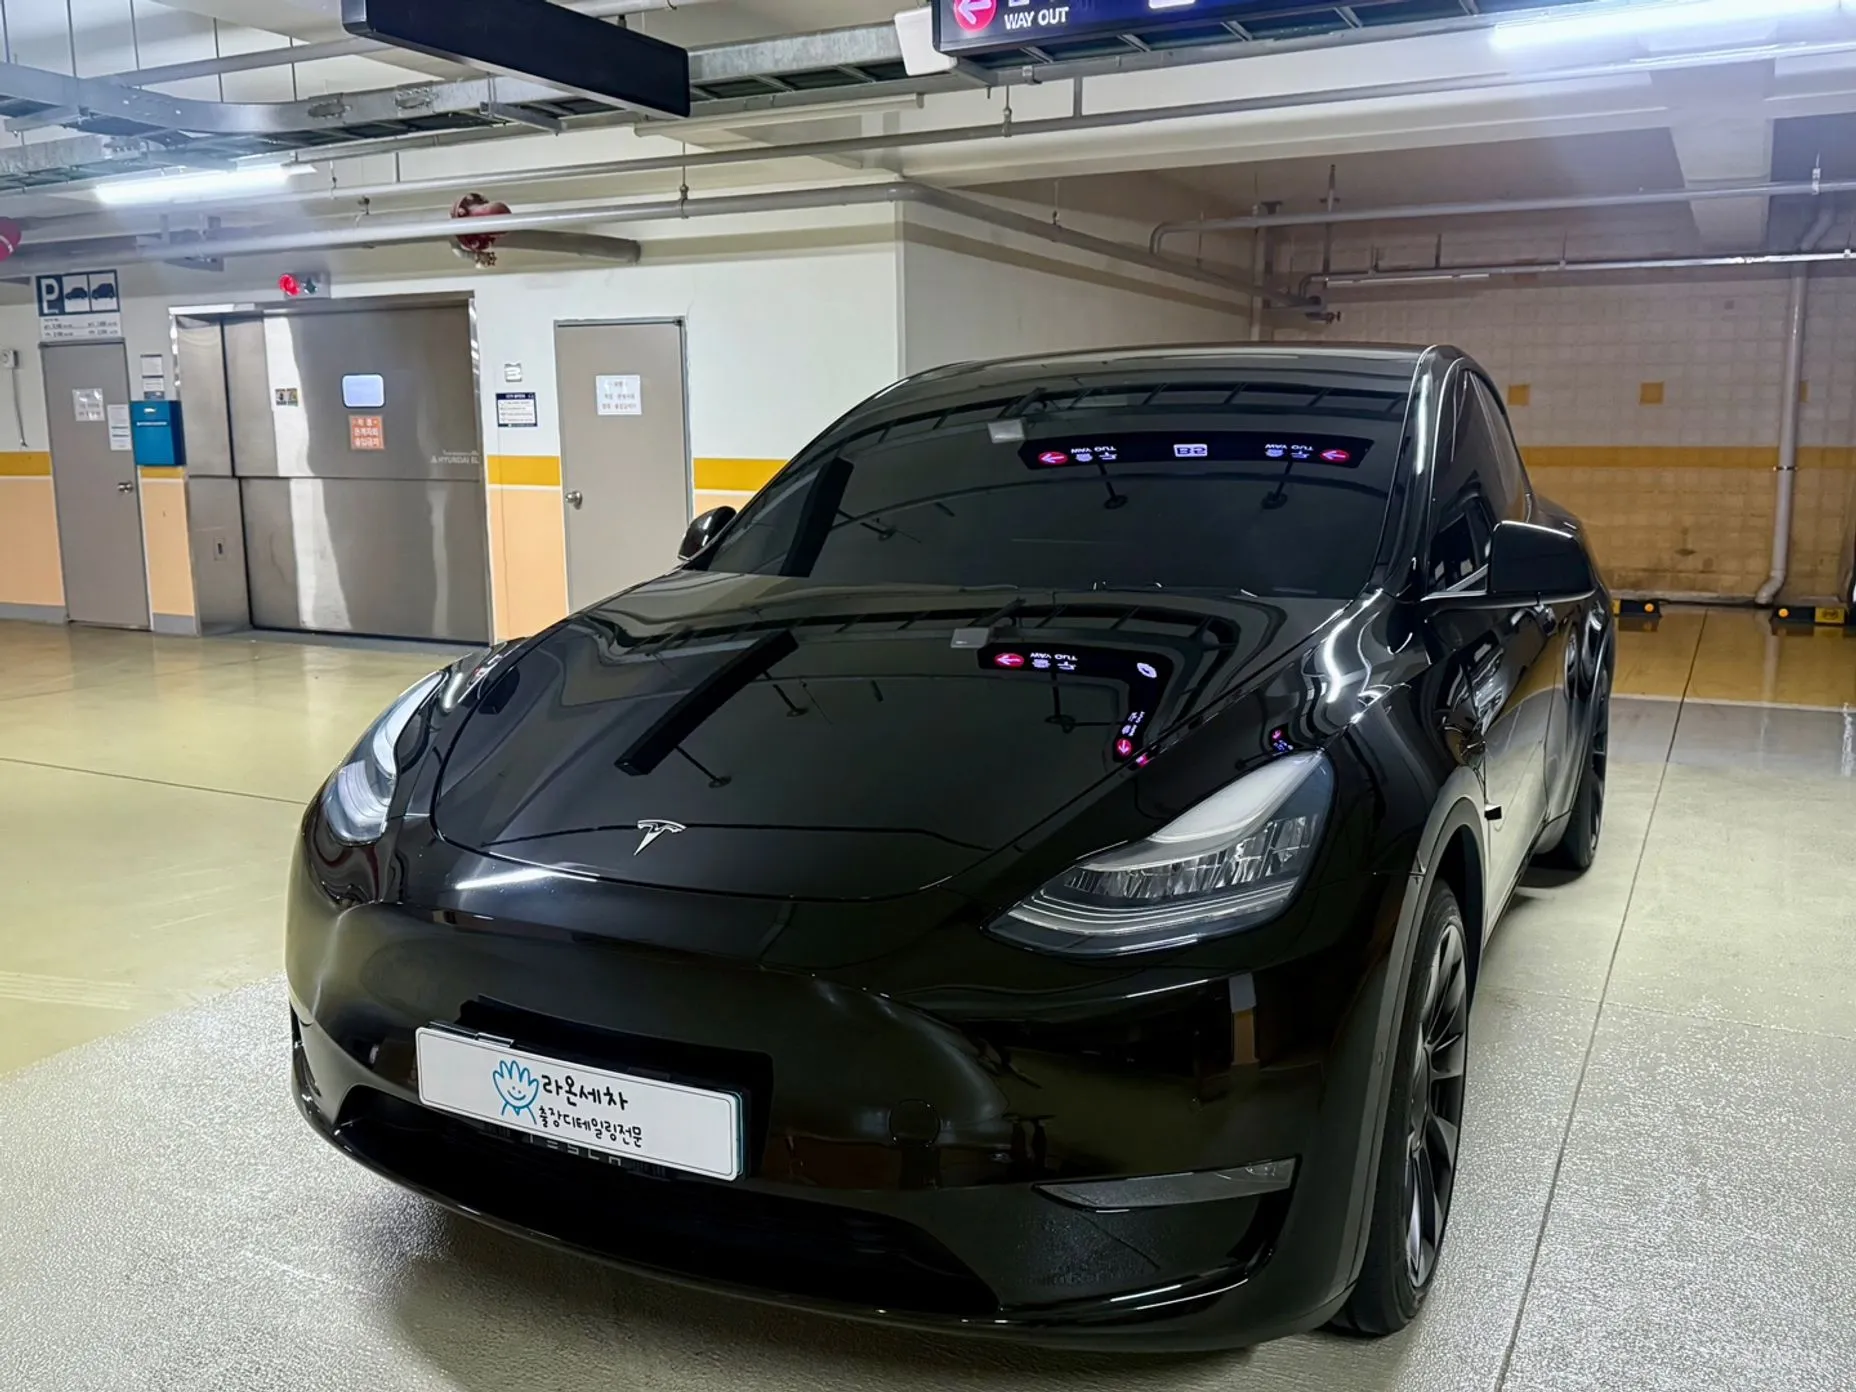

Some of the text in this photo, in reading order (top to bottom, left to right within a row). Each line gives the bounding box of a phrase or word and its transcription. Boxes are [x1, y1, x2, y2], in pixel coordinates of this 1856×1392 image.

[1004, 7, 1070, 30] WAY OUT
[541, 1074, 628, 1110] 라온세차
